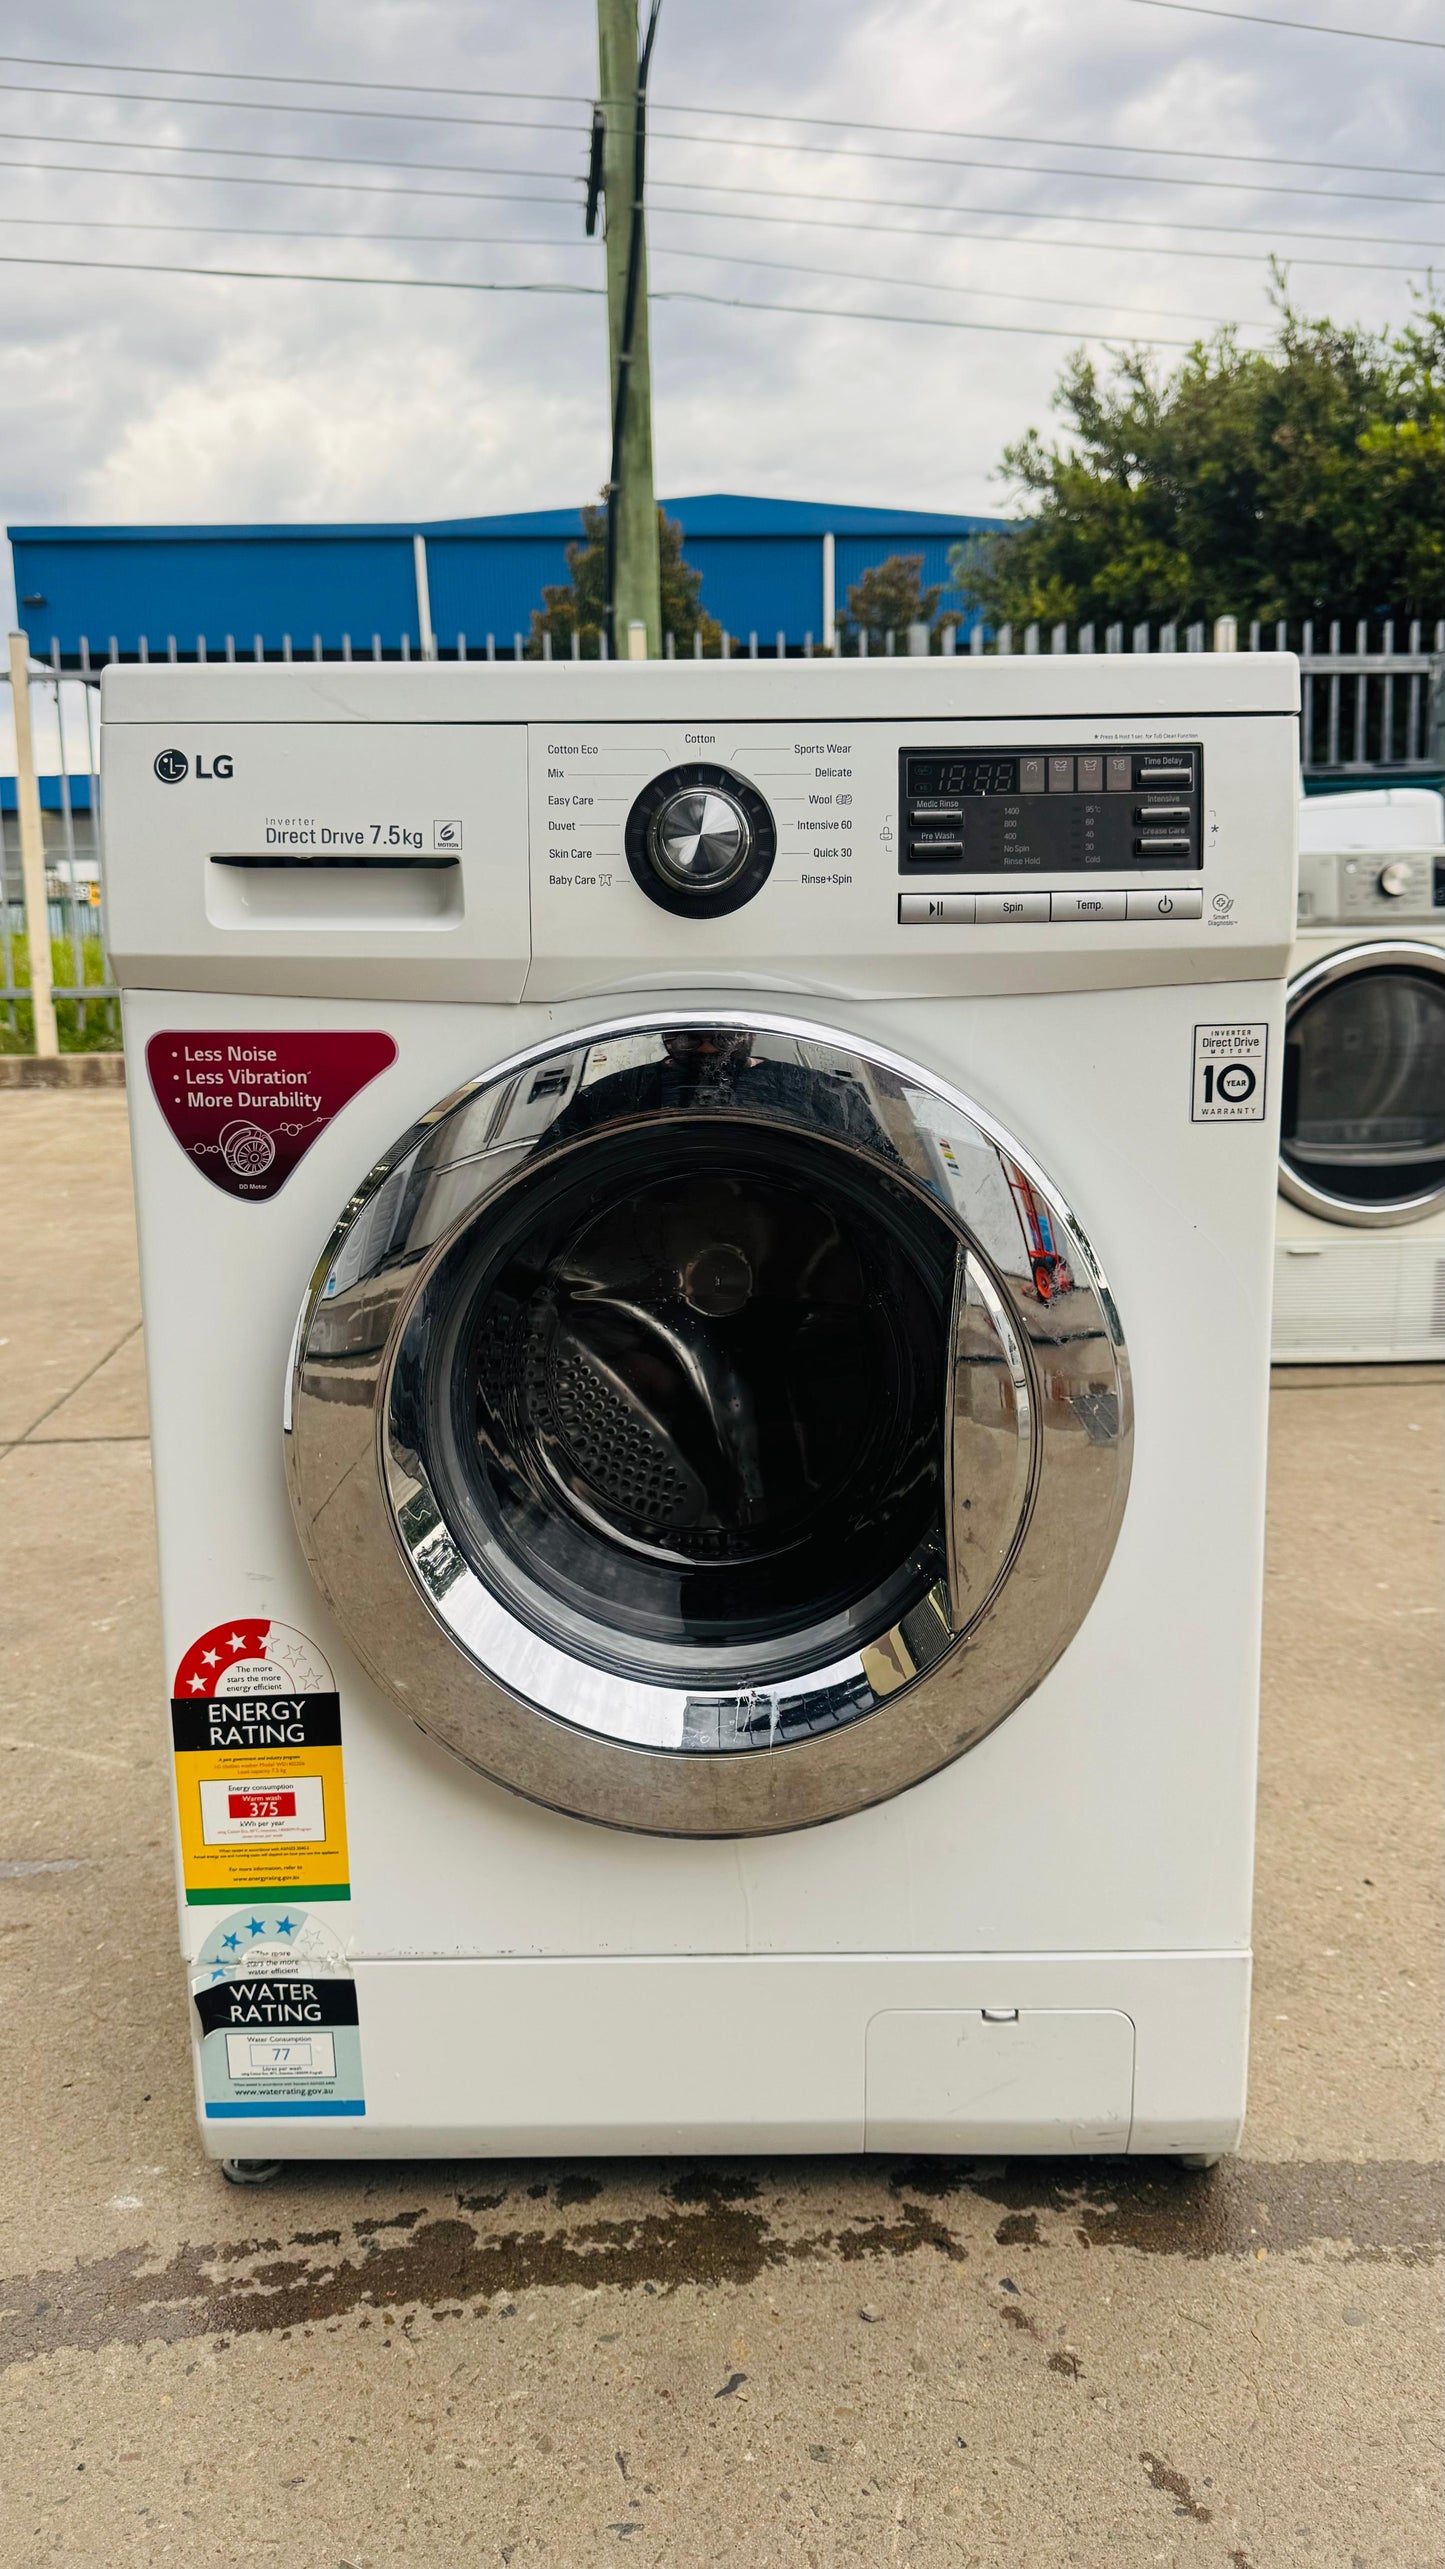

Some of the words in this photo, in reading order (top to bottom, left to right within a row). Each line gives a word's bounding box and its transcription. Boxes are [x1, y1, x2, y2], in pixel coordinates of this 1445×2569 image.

[685, 734, 716, 744] Cotton
[548, 744, 578, 754] Cotton
[581, 744, 598, 754] Eco
[794, 744, 824, 755] Sports
[827, 744, 852, 754] Wear
[196, 754, 233, 779] LG
[1144, 756, 1160, 764] Time
[1162, 756, 1184, 766] Delay
[548, 768, 564, 778] Mix
[815, 767, 852, 777] Delicate
[548, 796, 570, 808] Easy
[572, 796, 594, 806] Care
[808, 794, 832, 804] Wool
[916, 800, 938, 808] Medic
[940, 800, 958, 808] Rinse
[1148, 794, 1180, 802] Intensive
[266, 817, 316, 826] Inverter
[548, 820, 576, 830] Duvet
[797, 820, 839, 830] Intensive
[841, 820, 852, 830] 60
[266, 828, 316, 844] Direct
[321, 828, 364, 844] Drive
[549, 848, 568, 858] Skin
[570, 848, 592, 858] Care
[814, 848, 838, 859] Quick
[840, 848, 852, 858] 30
[550, 874, 572, 886] Baby
[574, 874, 596, 885] Care
[801, 874, 852, 886] Rinse+Spin
[1003, 901, 1024, 914] Spin
[1076, 900, 1104, 912] Temp.
[1202, 1038, 1232, 1048] Direct
[1234, 1037, 1260, 1047] Drive
[184, 1046, 222, 1062] Less
[228, 1046, 277, 1062] Noise
[186, 1070, 224, 1084] Less
[228, 1069, 308, 1084] Vibration
[1203, 1064, 1256, 1102] 10
[188, 1092, 232, 1108] More
[238, 1092, 322, 1112] Durability
[208, 1700, 306, 1722] ENERGY
[210, 1724, 304, 1746] RATING
[250, 1802, 278, 1817] 375
[230, 1984, 318, 2000] WATER
[230, 2004, 322, 2022] RATING
[272, 2048, 290, 2060] 77
[235, 2088, 334, 2096] www.waterrating.gov.au
